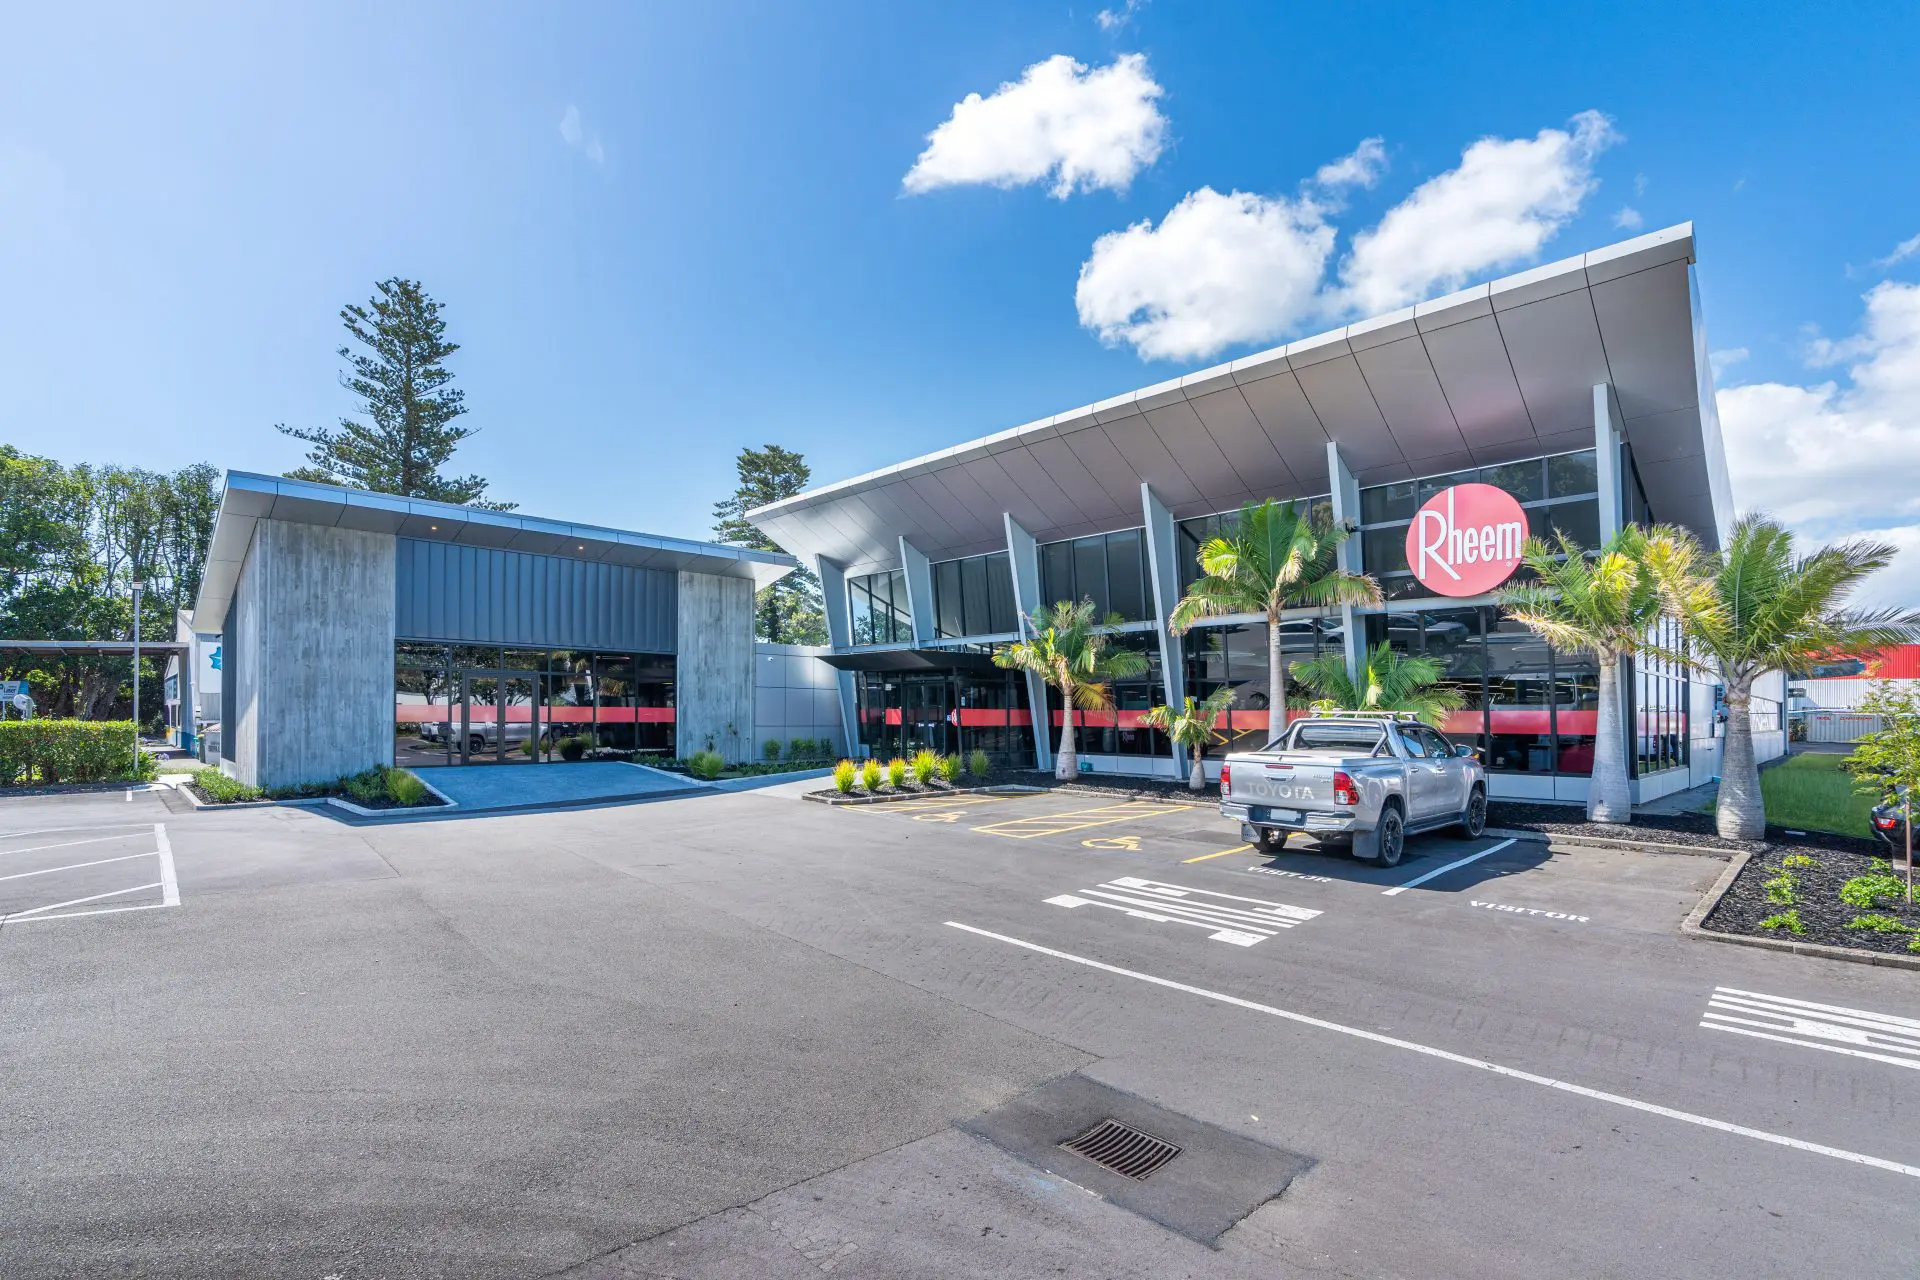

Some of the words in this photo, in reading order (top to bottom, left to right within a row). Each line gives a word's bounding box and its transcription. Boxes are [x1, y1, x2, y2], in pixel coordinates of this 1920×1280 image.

[1418, 486, 1521, 580] Rheem
[1246, 781, 1315, 800] TOYOTA
[1247, 866, 1333, 883] VISITOR
[1470, 900, 1590, 923] VISITOR
